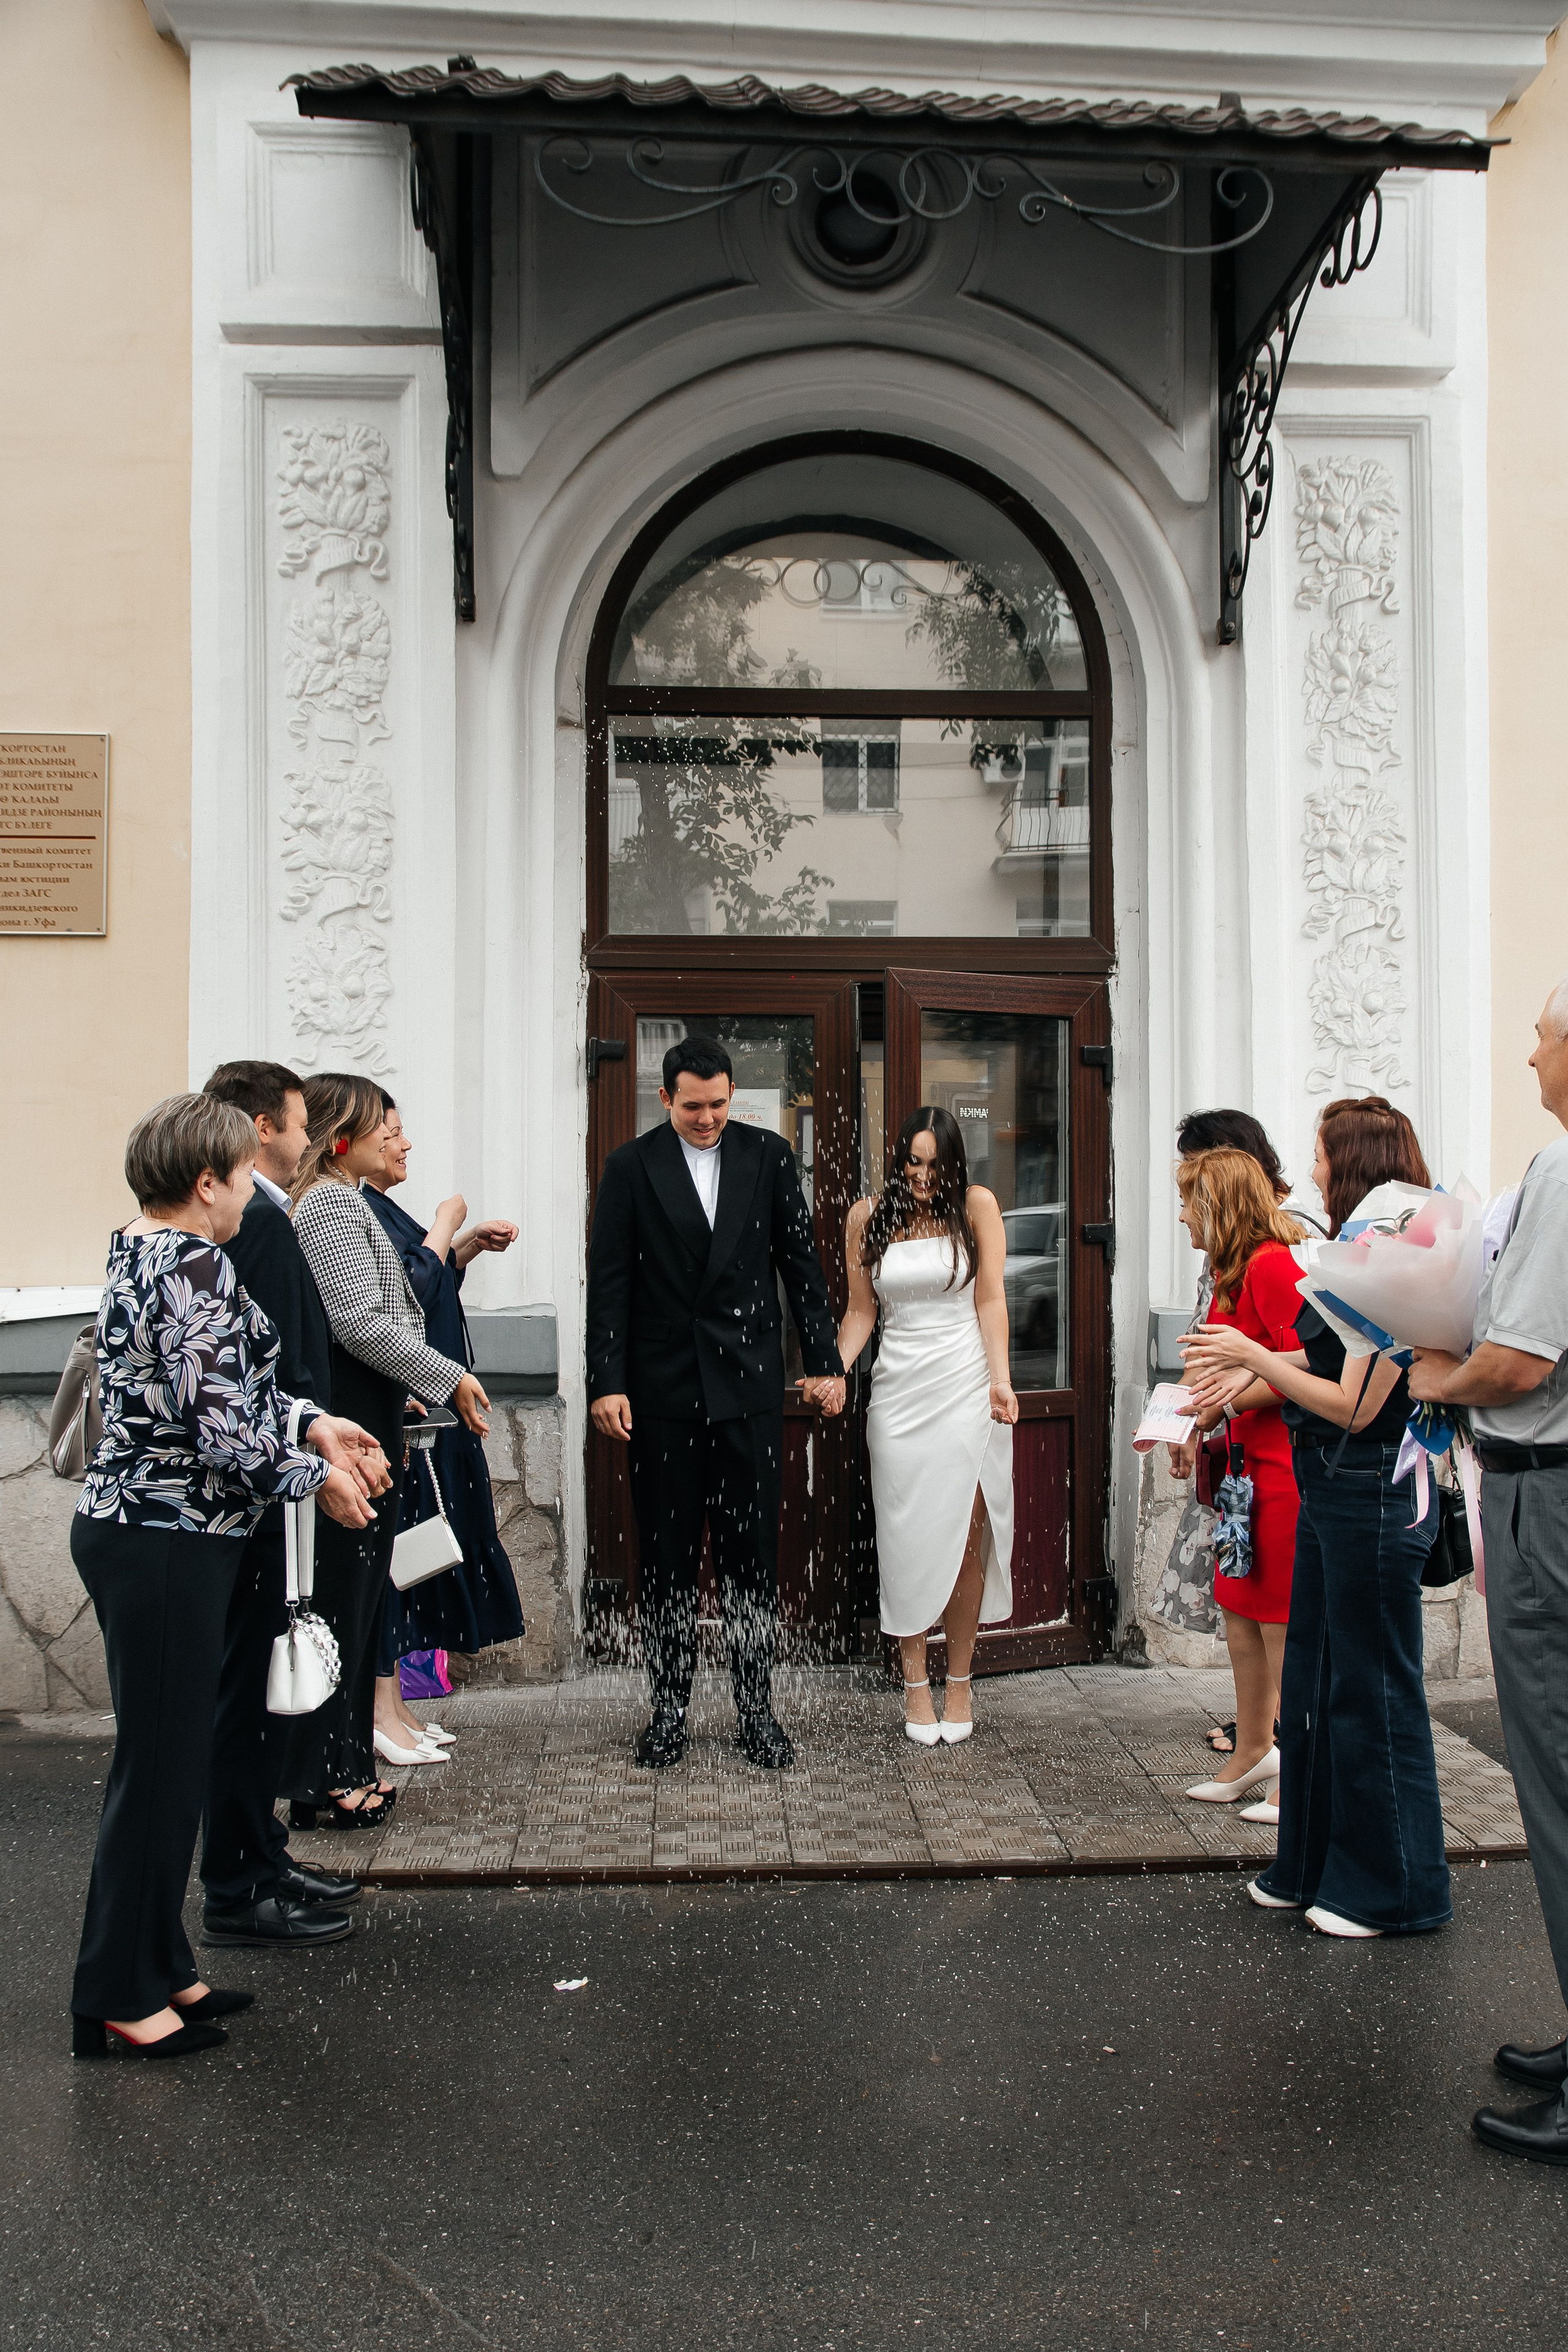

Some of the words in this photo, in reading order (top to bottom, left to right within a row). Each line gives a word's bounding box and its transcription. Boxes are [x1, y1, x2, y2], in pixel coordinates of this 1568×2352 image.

[12, 782, 73, 791] КОМИТЕТЫ
[13, 860, 93, 871] Башкортостан
[23, 889, 52, 897] ЗАГС
[34, 918, 56, 929] Уфа
